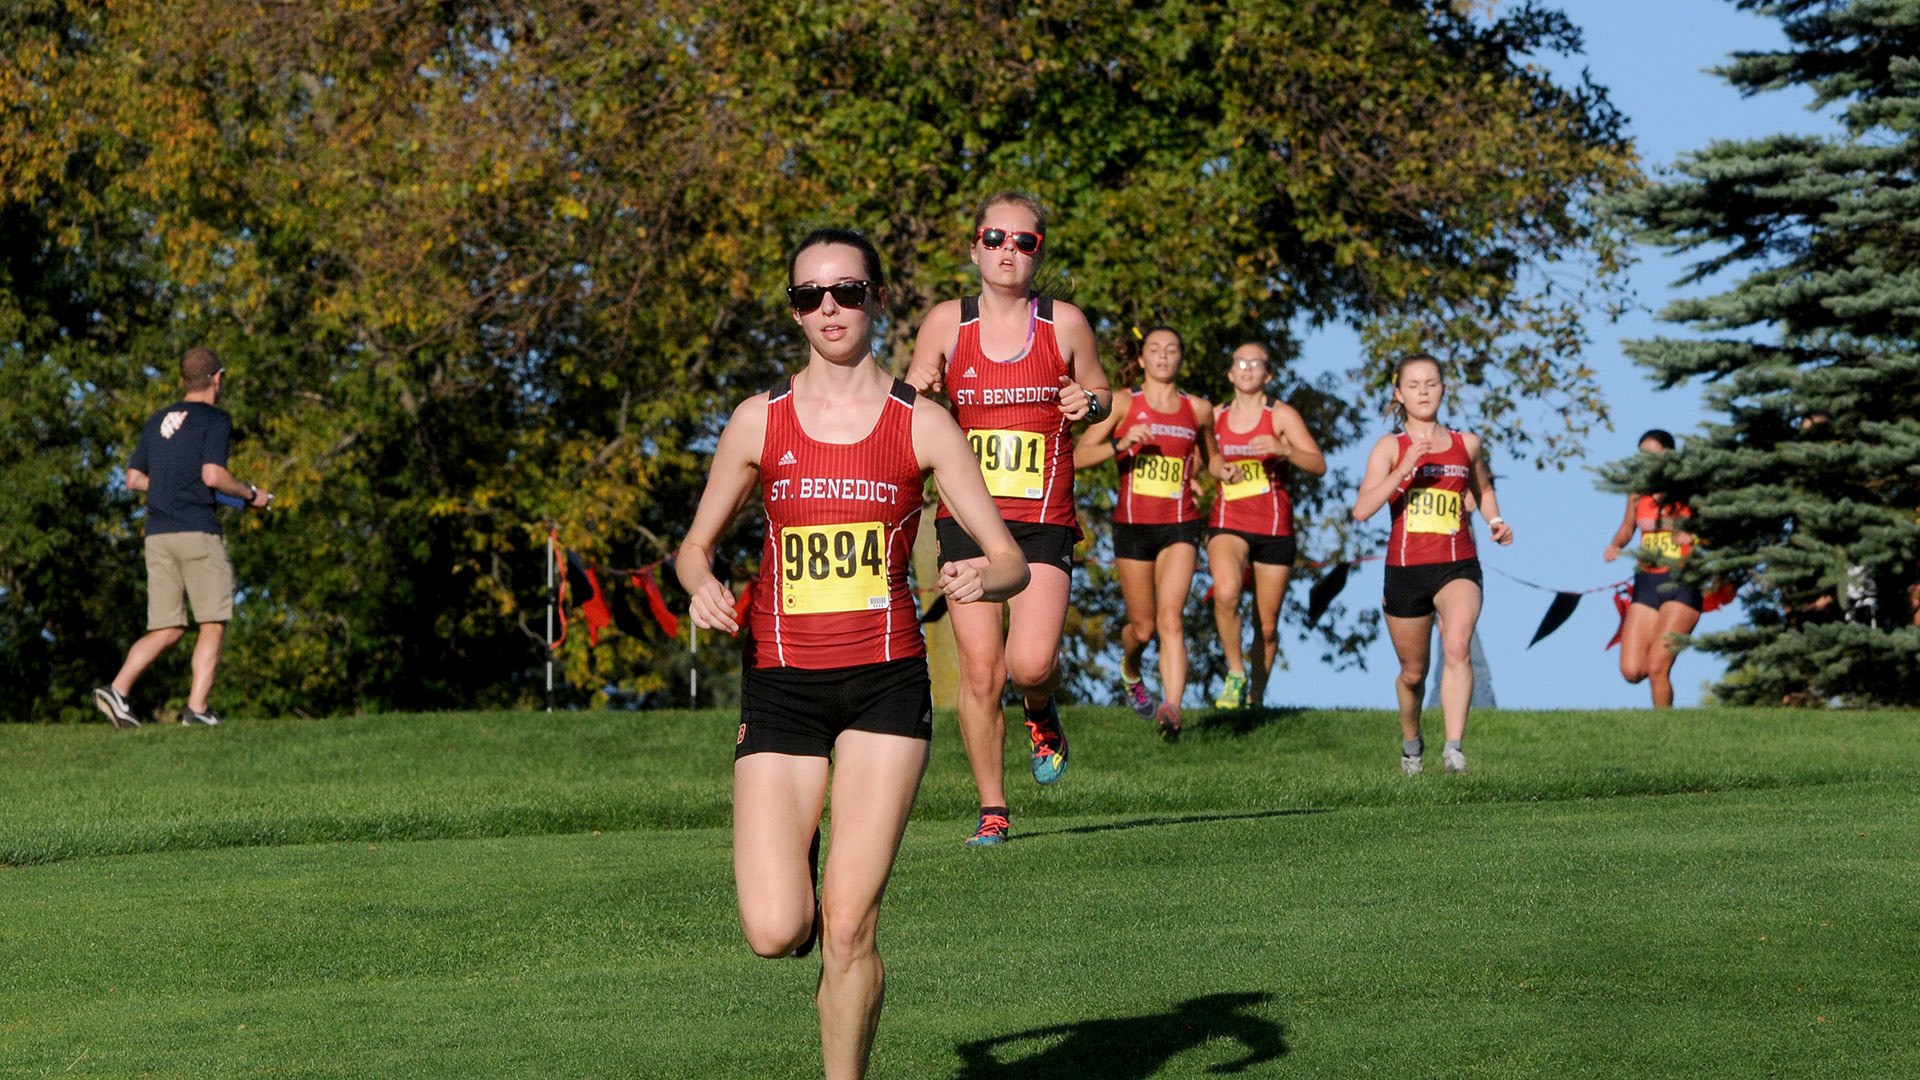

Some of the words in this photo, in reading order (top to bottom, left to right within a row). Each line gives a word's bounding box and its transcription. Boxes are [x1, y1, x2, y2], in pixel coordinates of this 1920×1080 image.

[957, 389, 979, 406] ST.
[983, 387, 1059, 405] BENEDICT
[1136, 453, 1181, 483] 9898
[771, 479, 794, 501] ST.
[799, 478, 898, 505] BENEDICT
[1409, 492, 1458, 519] 9904
[785, 529, 882, 581] 9894
